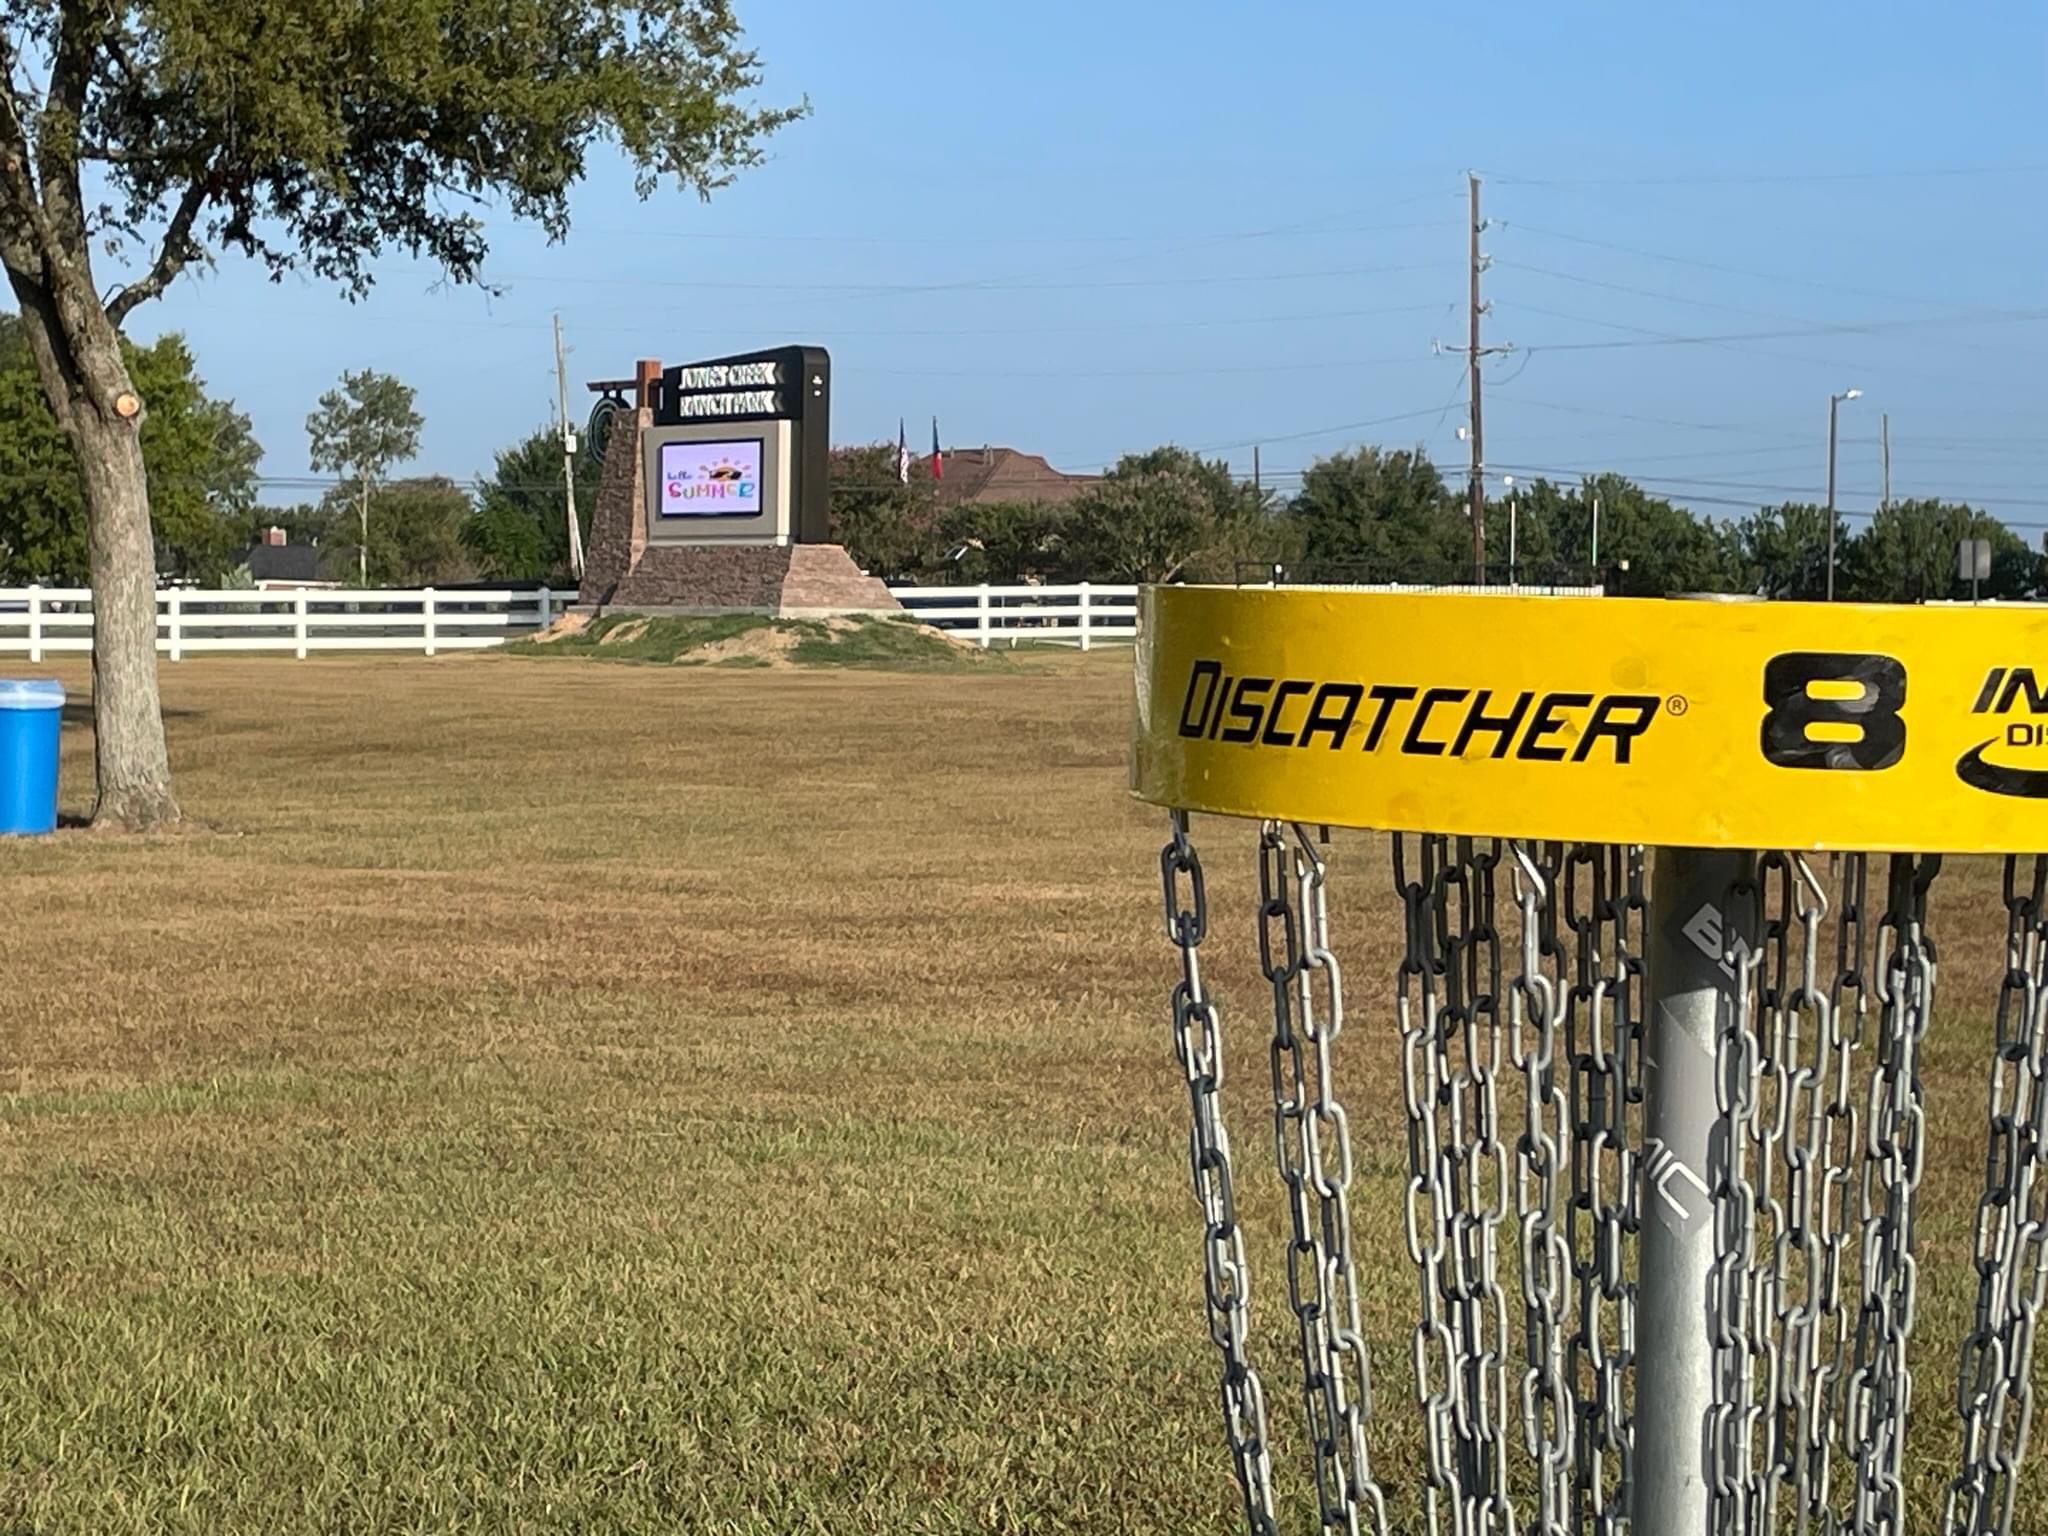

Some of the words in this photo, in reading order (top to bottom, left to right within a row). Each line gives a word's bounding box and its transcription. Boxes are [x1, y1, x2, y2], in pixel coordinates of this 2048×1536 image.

[679, 366, 728, 389] JONES
[729, 362, 777, 385] CREEK
[680, 393, 733, 417] RANCH
[734, 390, 776, 413] PARK
[1760, 651, 1907, 771] 8
